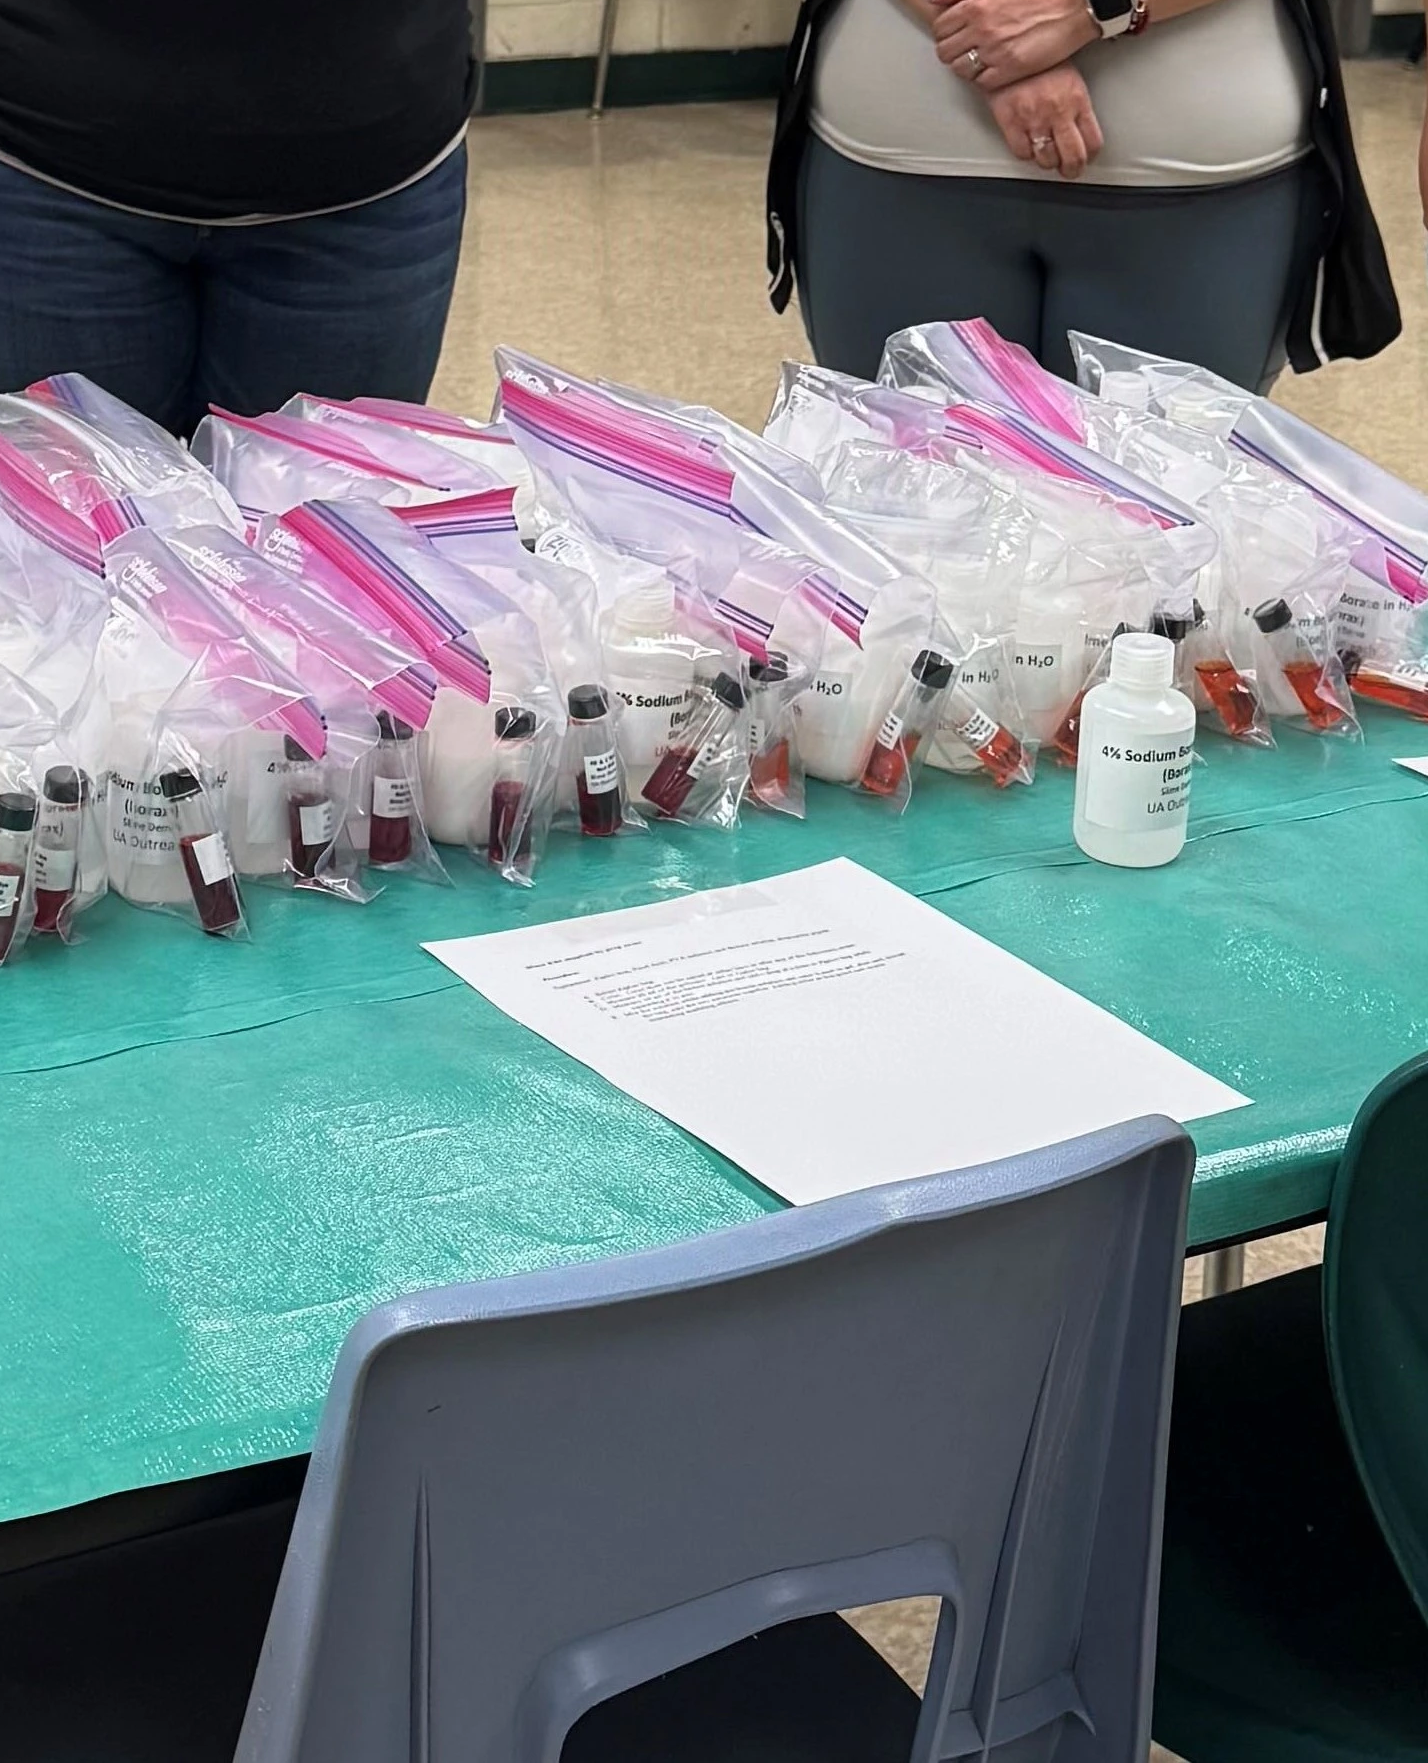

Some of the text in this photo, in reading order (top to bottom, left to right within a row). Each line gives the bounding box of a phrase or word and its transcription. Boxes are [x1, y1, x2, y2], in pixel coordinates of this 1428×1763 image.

[1028, 656, 1054, 668] H2O
[816, 682, 843, 695] H2O
[1102, 745, 1121, 759] 4%
[1125, 750, 1176, 762] Sodium
[1147, 802, 1164, 814] UA
